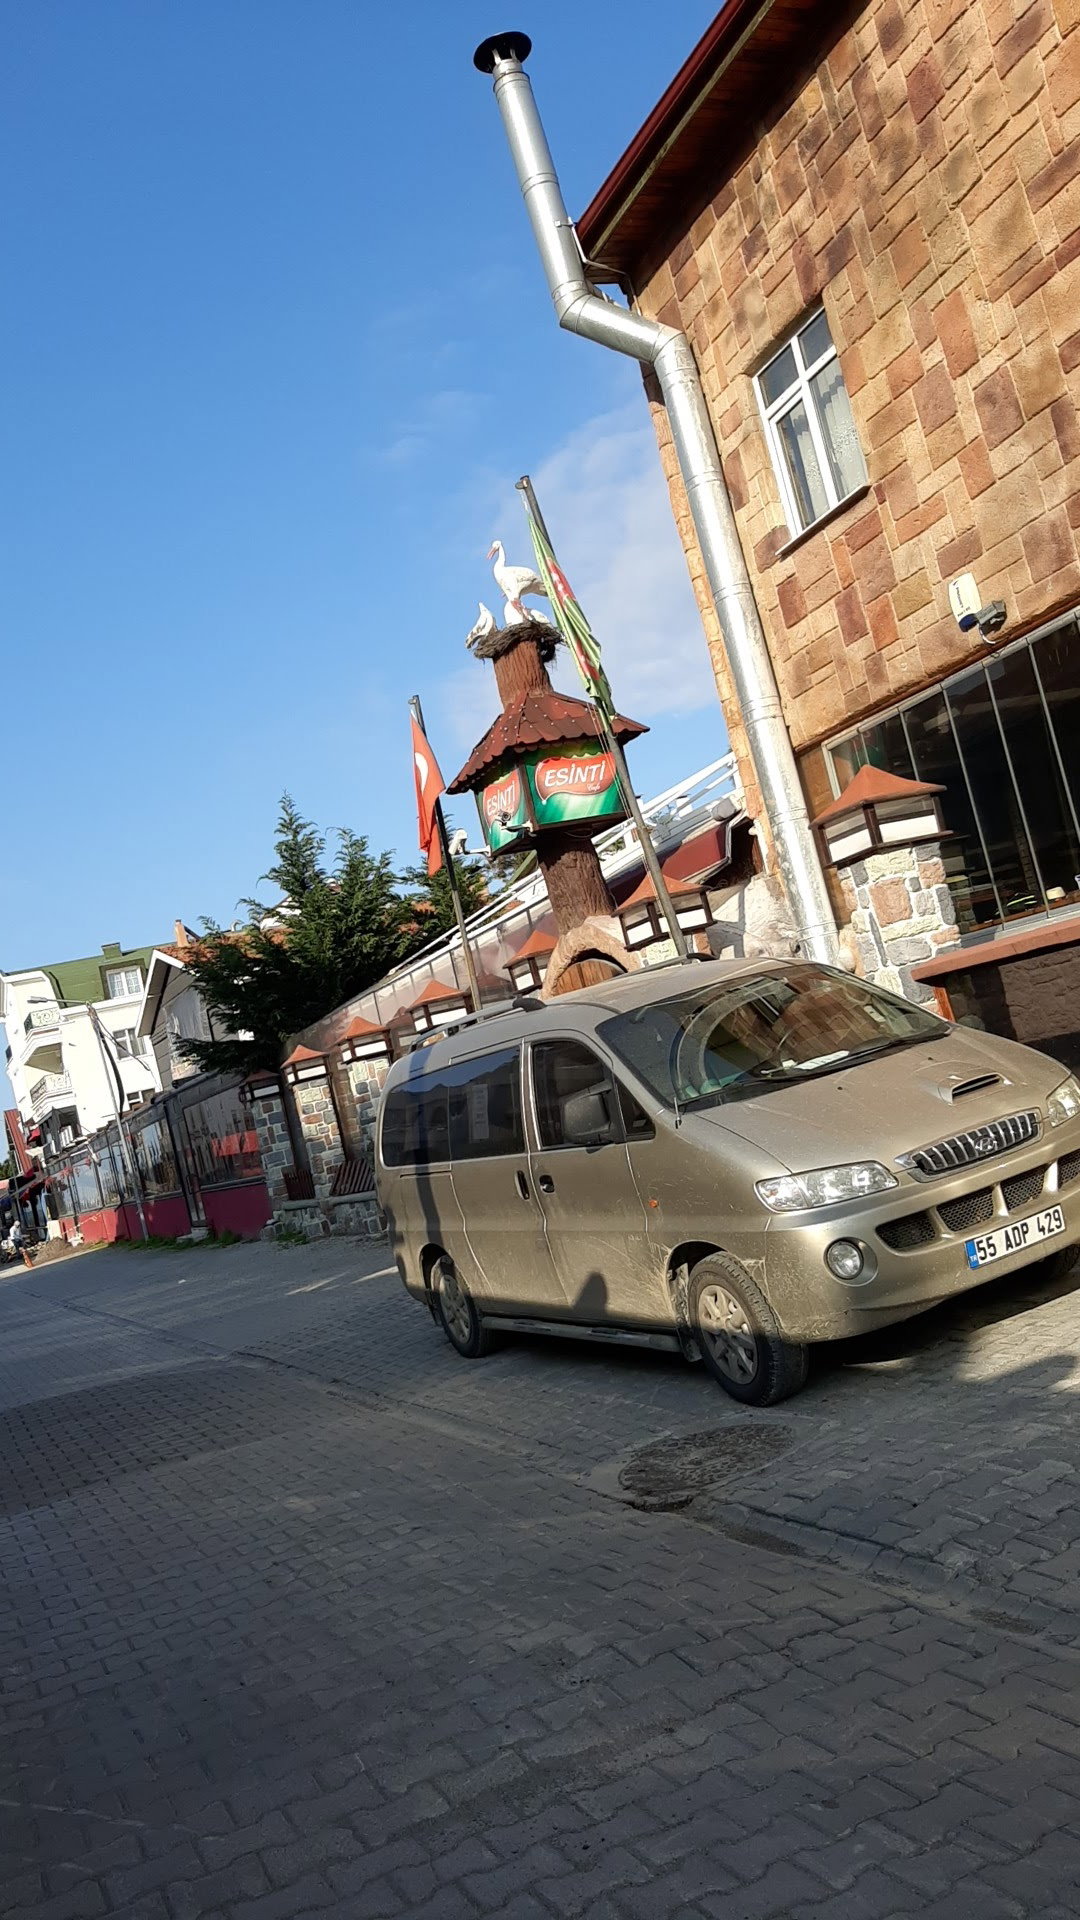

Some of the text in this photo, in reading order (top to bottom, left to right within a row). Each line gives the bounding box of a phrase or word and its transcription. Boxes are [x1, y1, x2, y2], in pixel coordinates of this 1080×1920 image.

[544, 760, 606, 787] ESİNTİ
[976, 1208, 1062, 1261] 55 ADP 429
